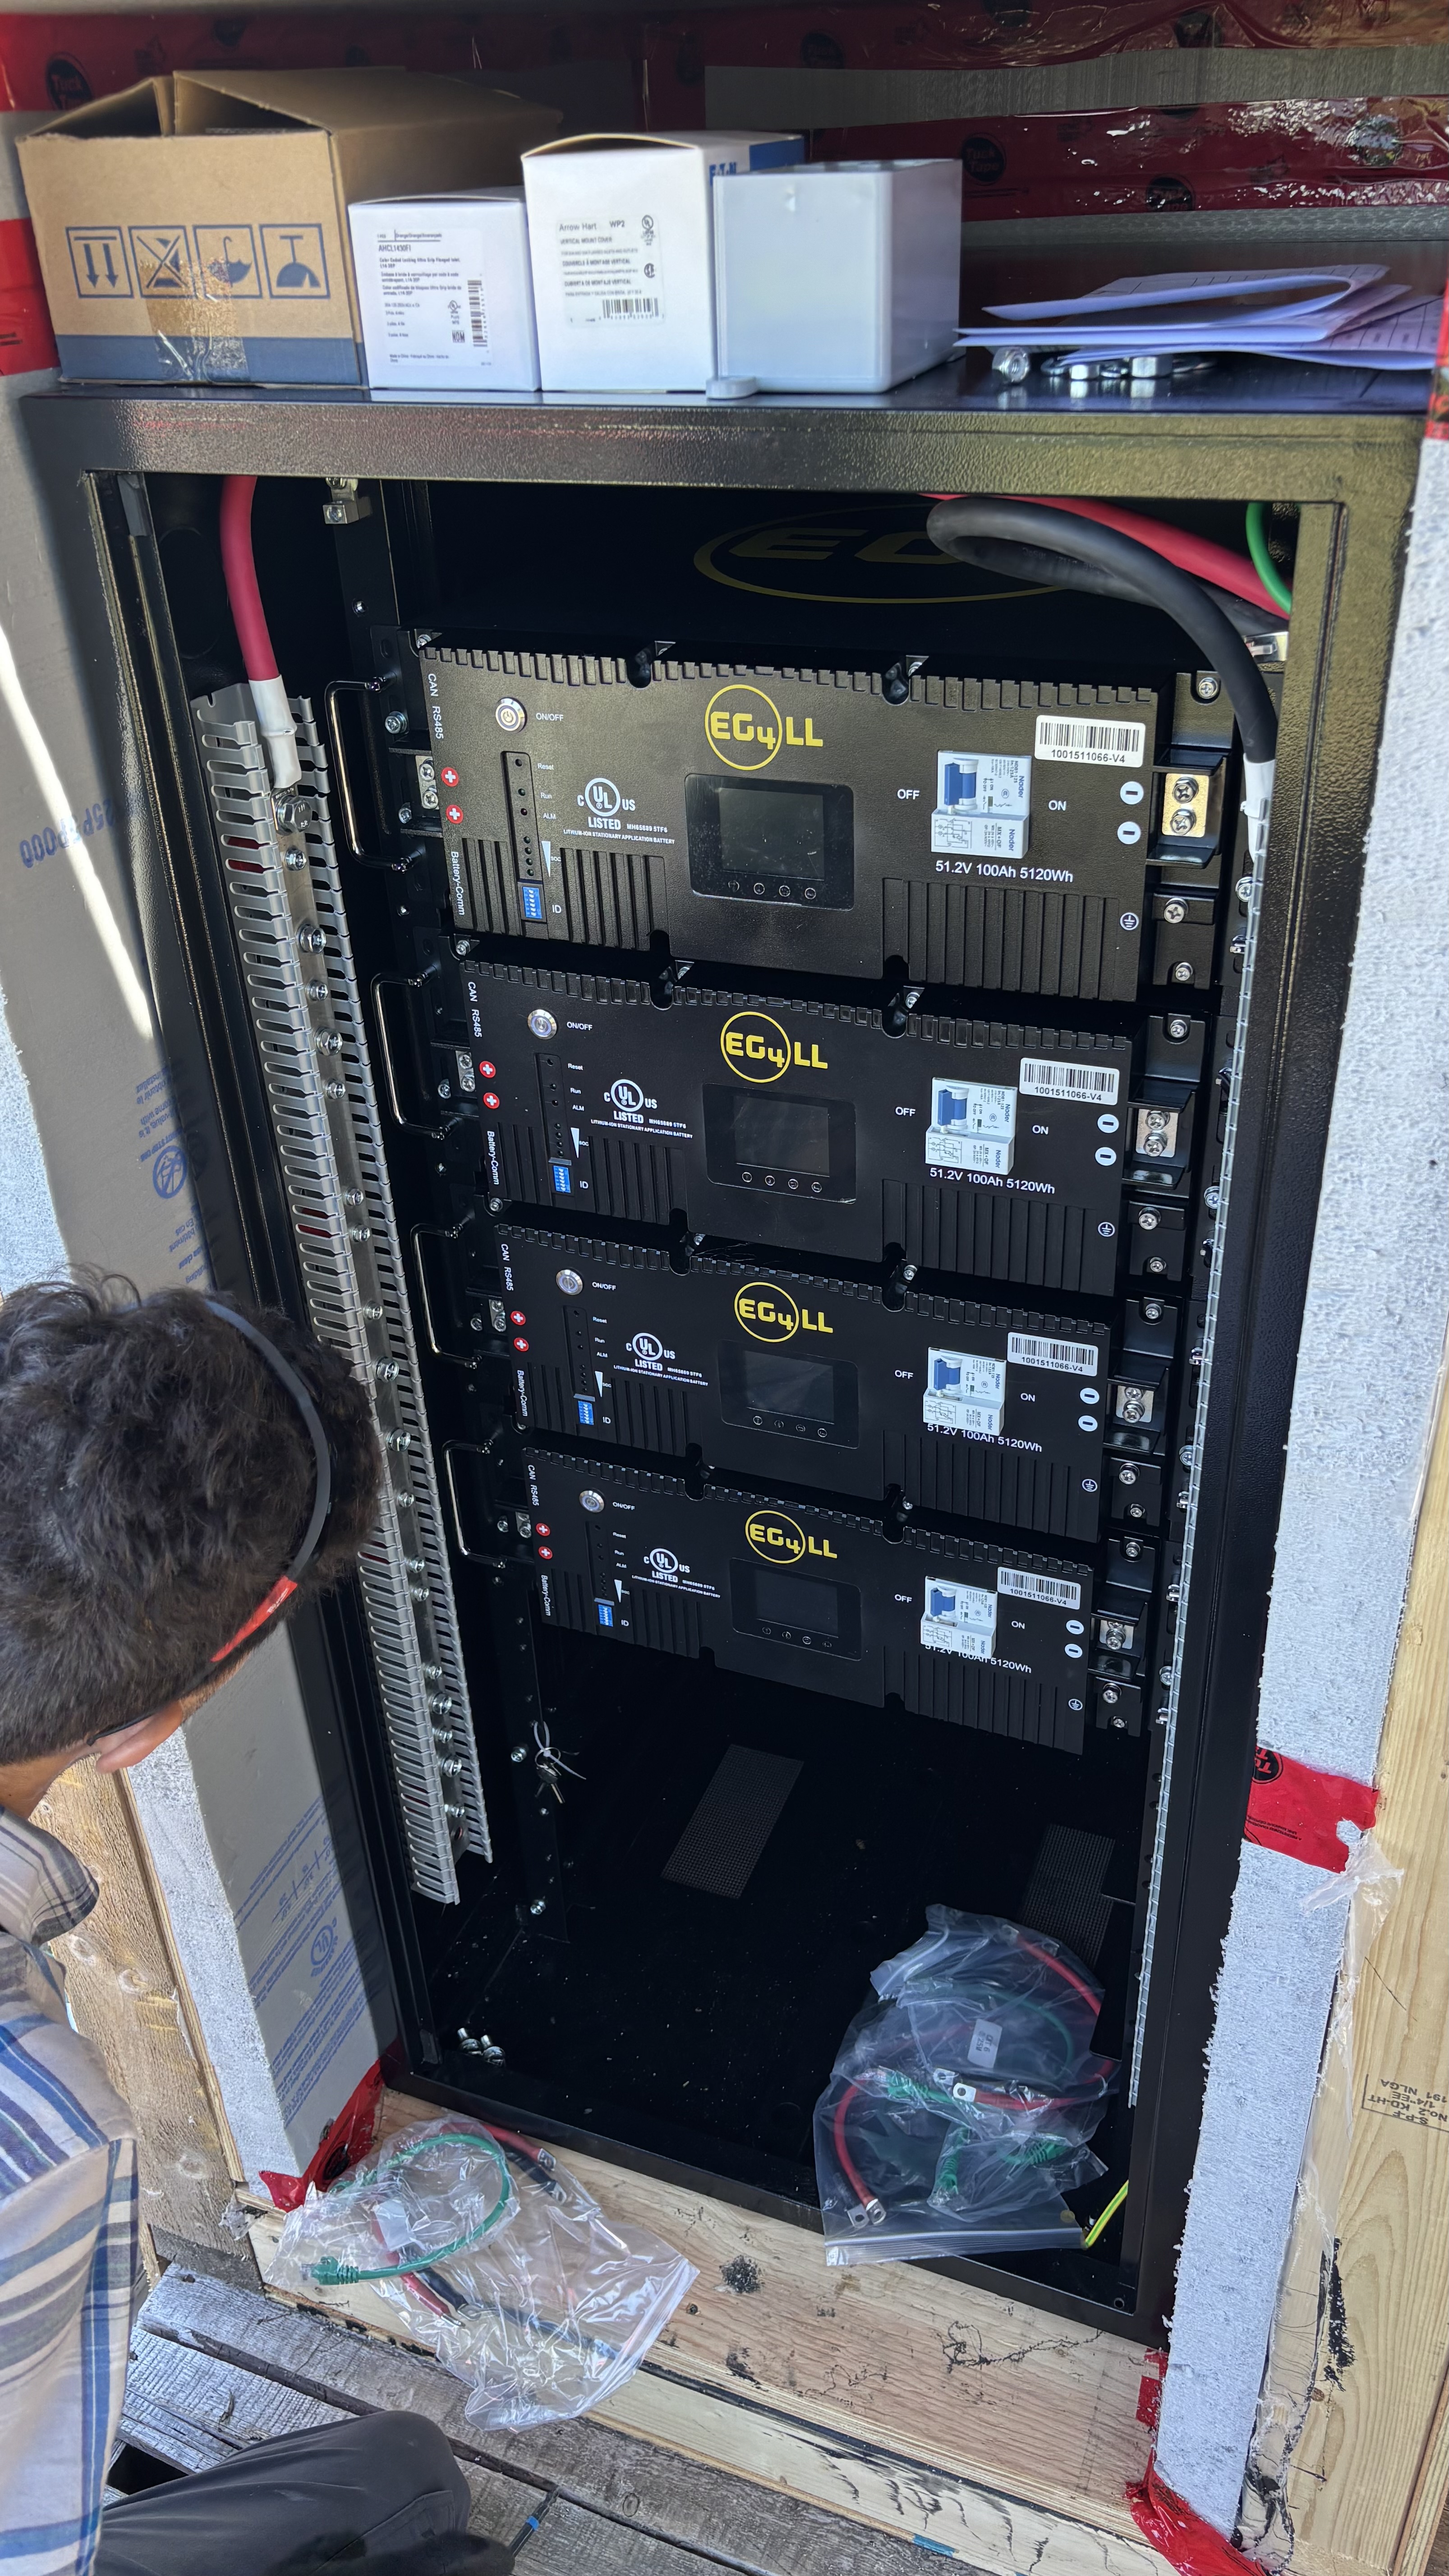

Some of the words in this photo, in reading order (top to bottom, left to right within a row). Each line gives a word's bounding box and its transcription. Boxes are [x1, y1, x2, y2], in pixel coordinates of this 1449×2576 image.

[452, 331, 465, 343] NOM
[428, 673, 438, 697] CAN
[432, 705, 444, 740] RS485
[535, 713, 564, 722] ON/OFF
[1051, 749, 1126, 764] 1001511066-V4
[897, 788, 920, 800] OFF
[622, 798, 636, 811] US
[1048, 800, 1067, 811] ON
[588, 817, 621, 830] LISTED
[563, 829, 592, 837] LITHIUM-ION
[593, 832, 621, 840] STATIONARY
[935, 860, 972, 874] 51.2V
[976, 864, 1016, 878] 100Ah
[1019, 867, 1073, 883] 5120Wh
[451, 851, 465, 916] Battery-Comm
[552, 905, 562, 913] ID
[468, 981, 478, 1002] CAN
[471, 1009, 482, 1037] RS485
[566, 1021, 593, 1031] ON/OFF
[1034, 1086, 1102, 1101] 1001511066-V4
[644, 1098, 658, 1109] US
[613, 1110, 644, 1124] LISTED
[895, 1107, 916, 1117] OFF
[617, 1123, 644, 1132] STATIONARY
[644, 1127, 673, 1136] APPLICATION
[1032, 1125, 1049, 1135] ON
[487, 1131, 499, 1186] Battery-Comm
[580, 1180, 589, 1189] ID
[929, 1167, 963, 1181] 51.2V
[967, 1173, 1003, 1187] 100Ah
[1006, 1178, 1055, 1194] 5120Wh
[501, 1243, 510, 1261] CAN
[504, 1266, 514, 1291] RS485
[592, 1282, 616, 1291] ON/OFF
[664, 1349, 676, 1359] US
[634, 1358, 663, 1371] LISTED
[1021, 1357, 1083, 1373] 1001511066-V4
[894, 1370, 914, 1380] OFF
[517, 1369, 528, 1417] Battery-Comm
[1020, 1393, 1035, 1402] ON
[927, 1423, 958, 1436] 51.2V
[961, 1429, 994, 1444] 100Ah
[997, 1436, 1042, 1452] 5120Wh
[528, 1464, 536, 1481] CAN
[530, 1484, 539, 1506] RS485
[612, 1501, 635, 1511] ON/OFF
[679, 1564, 690, 1573] US
[652, 1570, 678, 1583] LISTED
[541, 1575, 551, 1616] Battery-Comm
[894, 1594, 912, 1603] OFF
[1010, 1588, 1067, 1605] 1001511066-V4
[1011, 1620, 1026, 1629] ON
[990, 1657, 1032, 1674] 5120Wh
[1380, 2079, 1417, 2096] NLGA
[1426, 2092, 1448, 2103] 191
[1367, 2094, 1410, 2111] KD-HT
[1418, 2107, 1448, 2122] No.2
